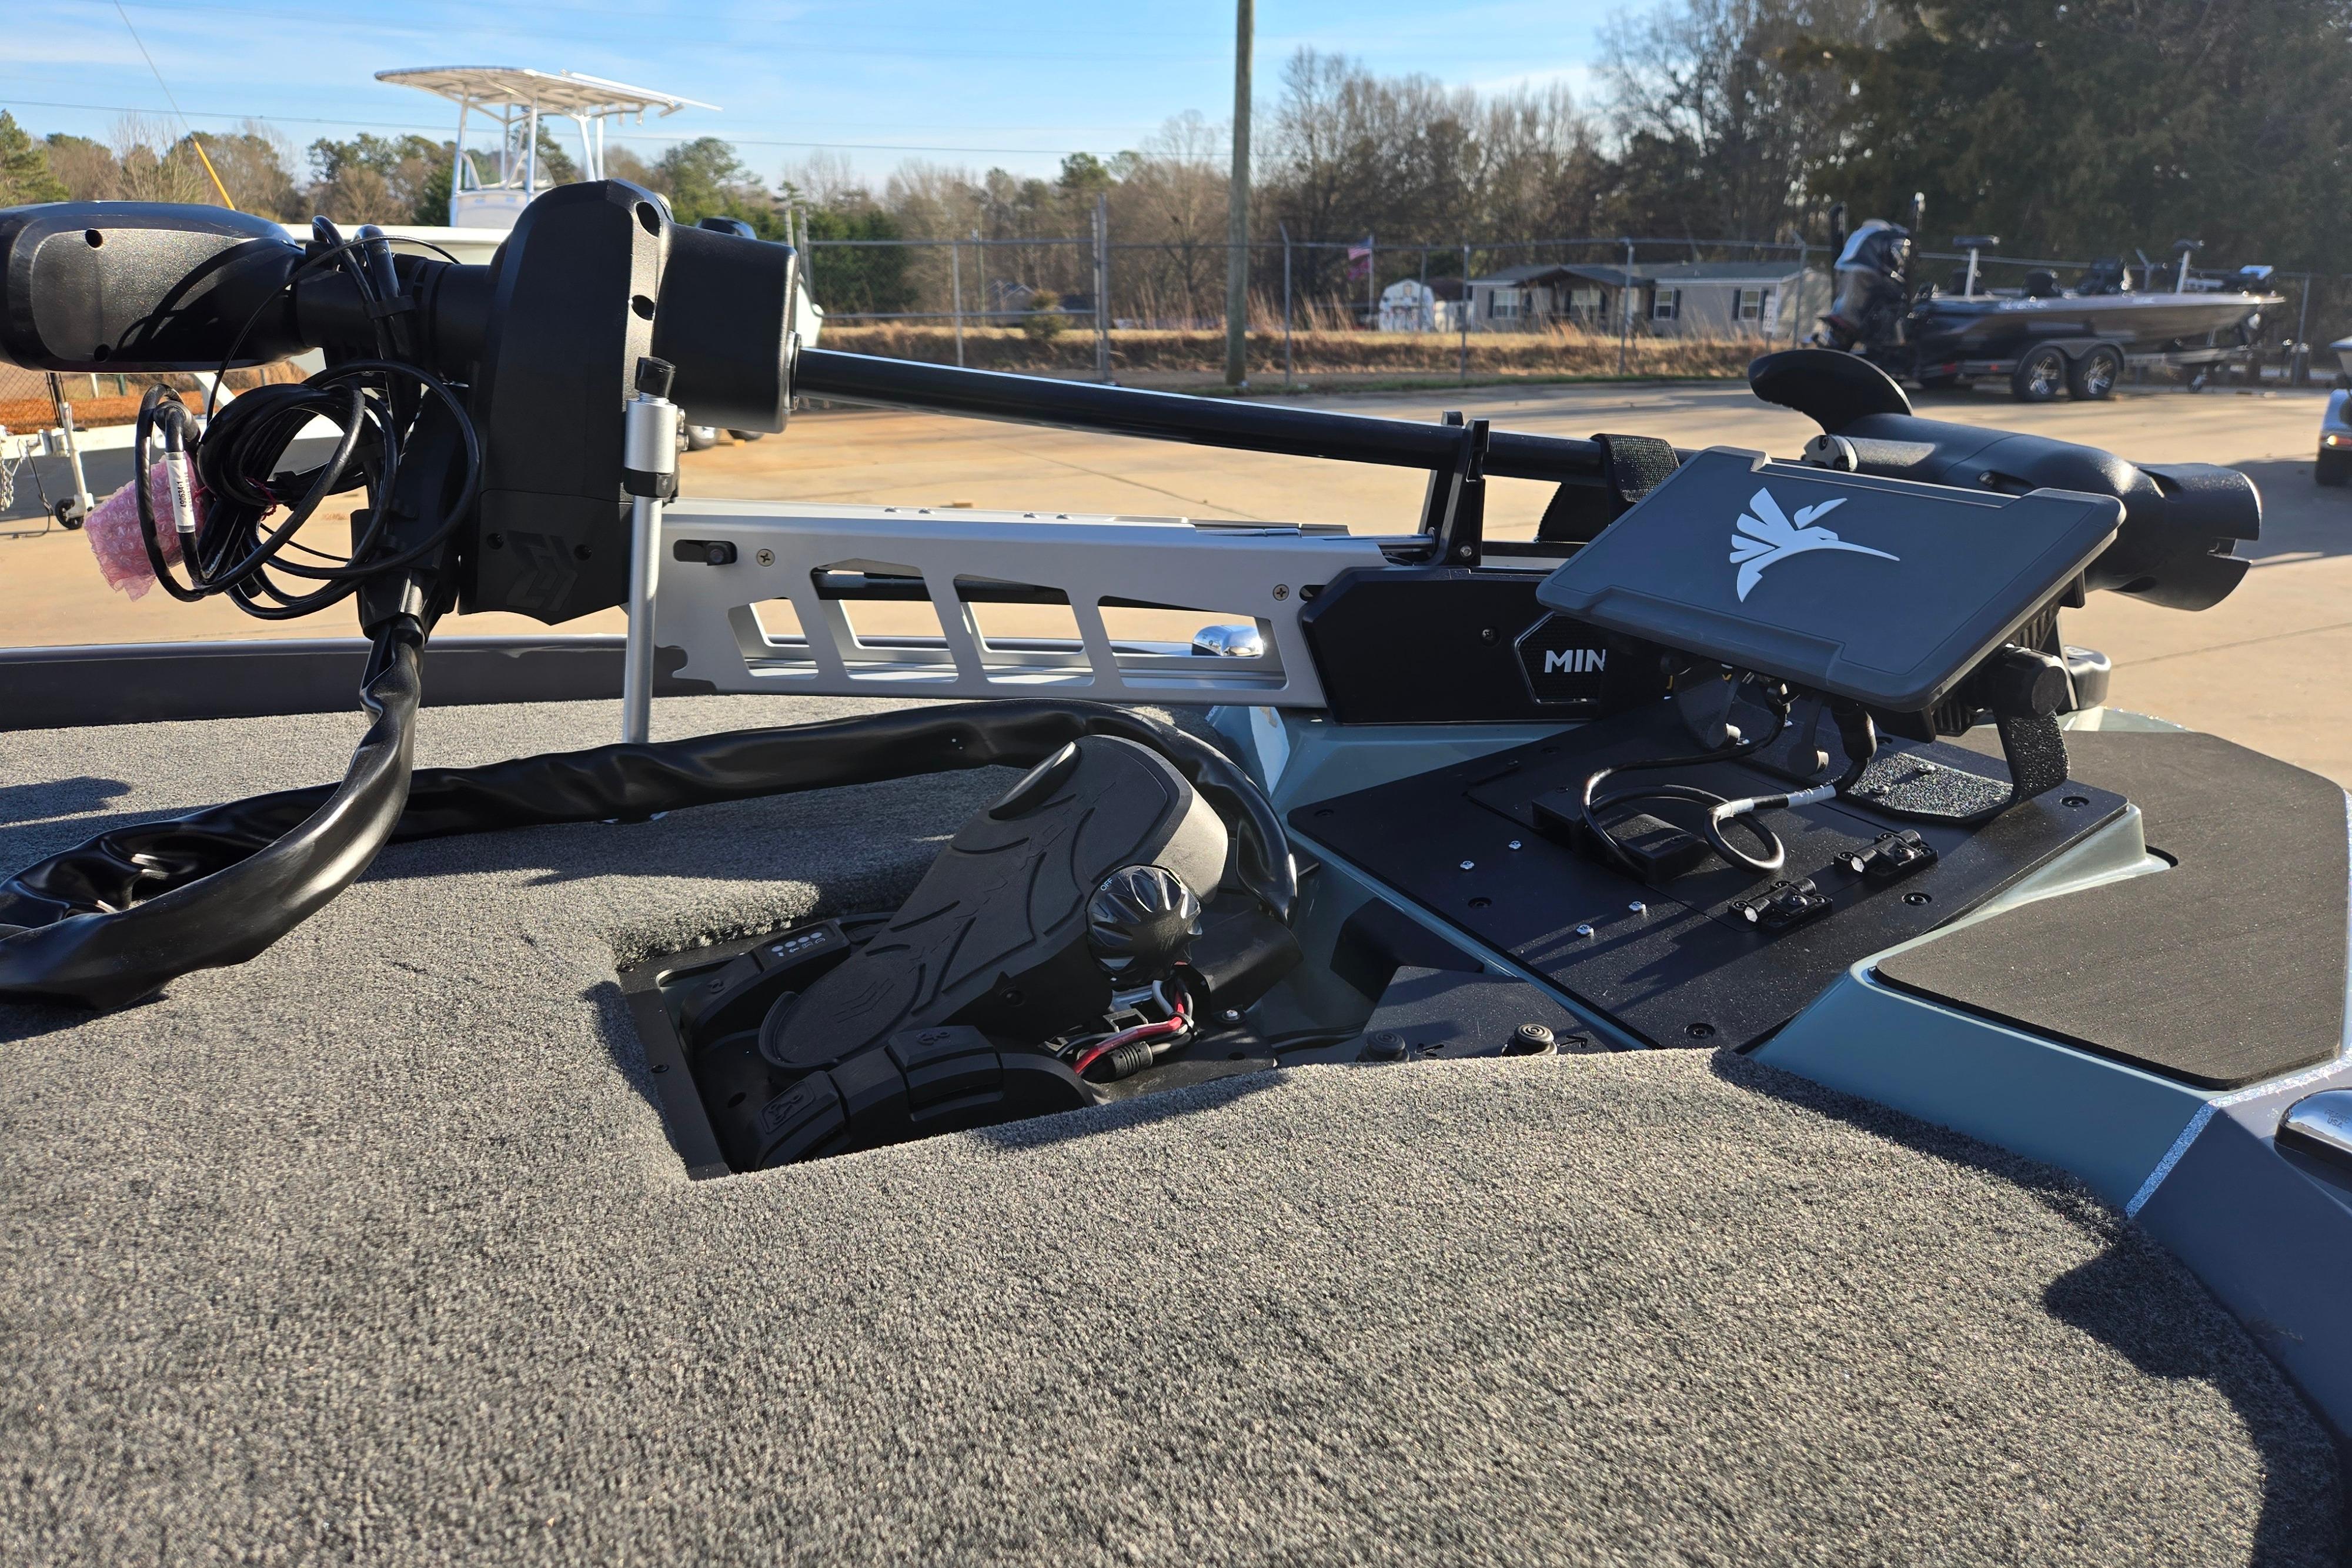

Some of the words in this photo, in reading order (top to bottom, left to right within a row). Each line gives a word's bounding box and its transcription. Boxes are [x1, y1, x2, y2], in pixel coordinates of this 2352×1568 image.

[176, 481, 187, 508] 490634-1
[1100, 877, 1112, 891] OFF
[2327, 1117, 2343, 1128] USA
